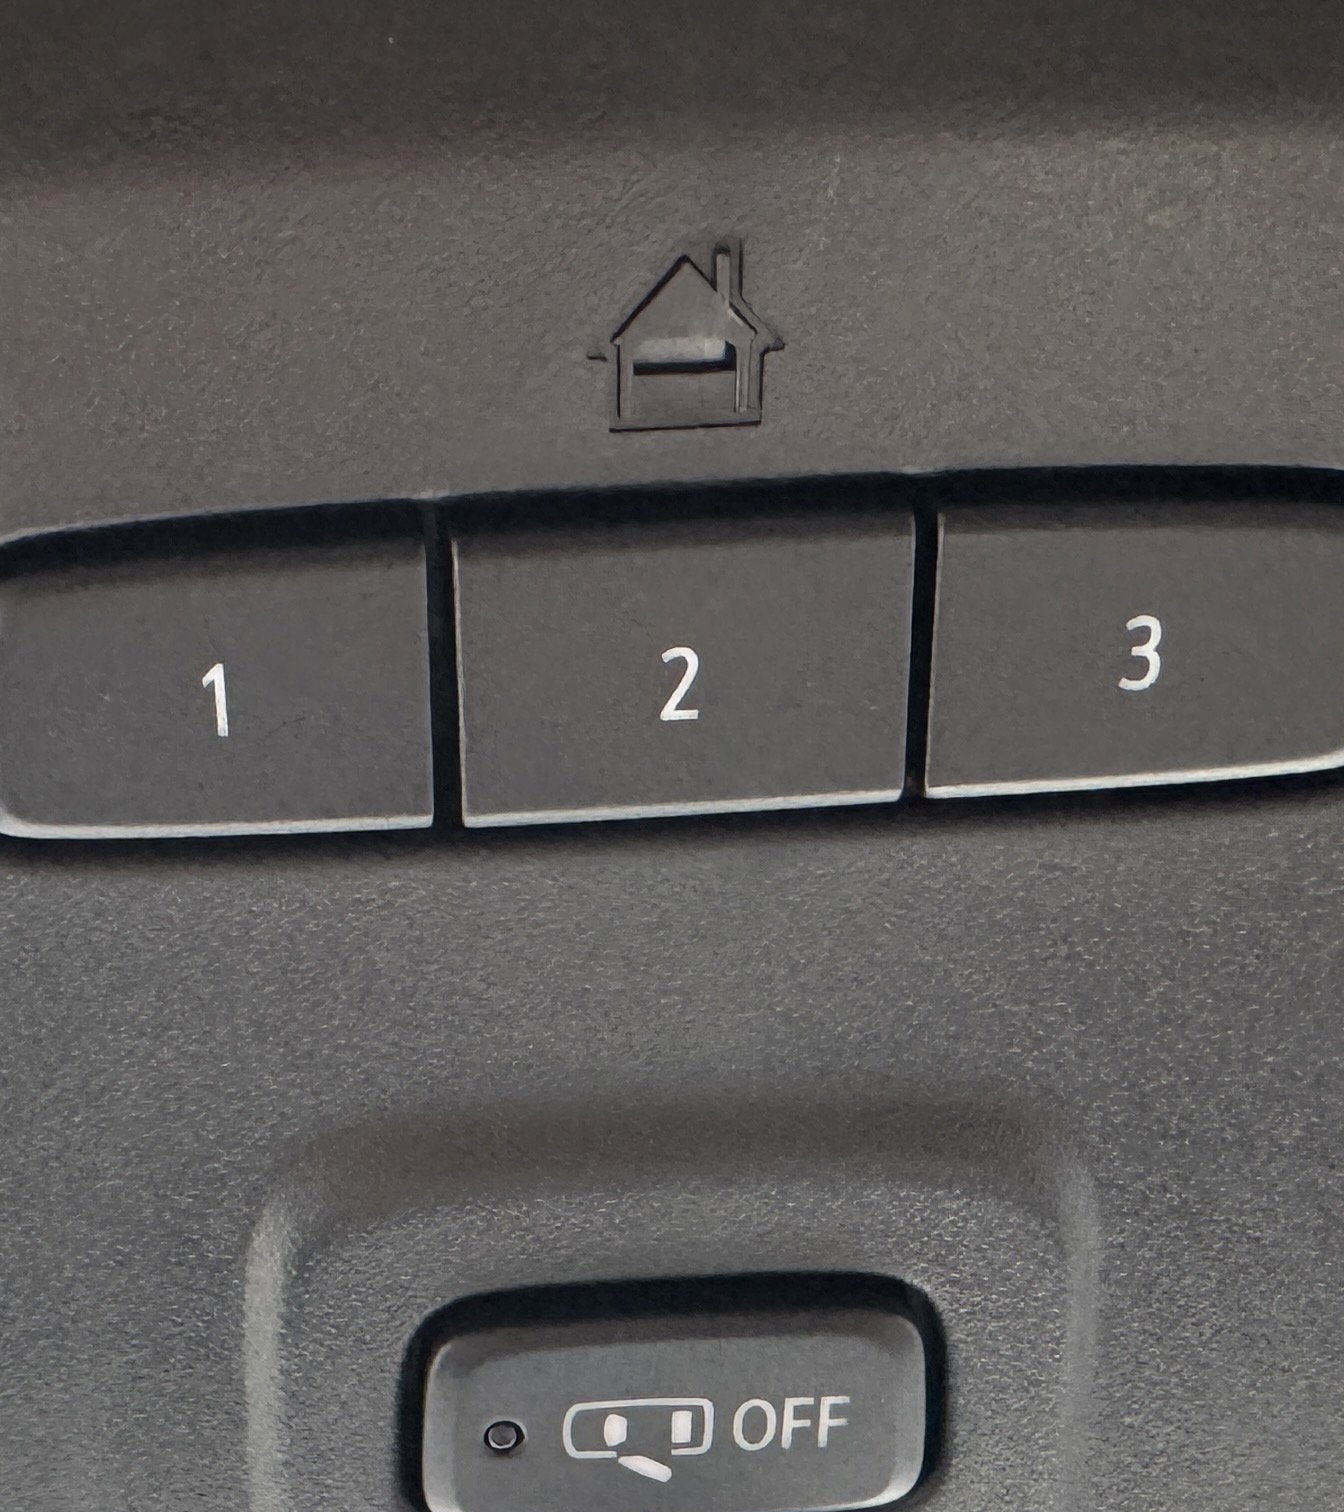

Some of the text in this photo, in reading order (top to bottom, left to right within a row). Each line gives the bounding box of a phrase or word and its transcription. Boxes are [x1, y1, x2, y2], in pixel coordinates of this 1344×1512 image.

[659, 645, 699, 721] 2
[1117, 614, 1162, 691] 3
[201, 662, 229, 737] 1
[733, 1395, 850, 1452] OFF
